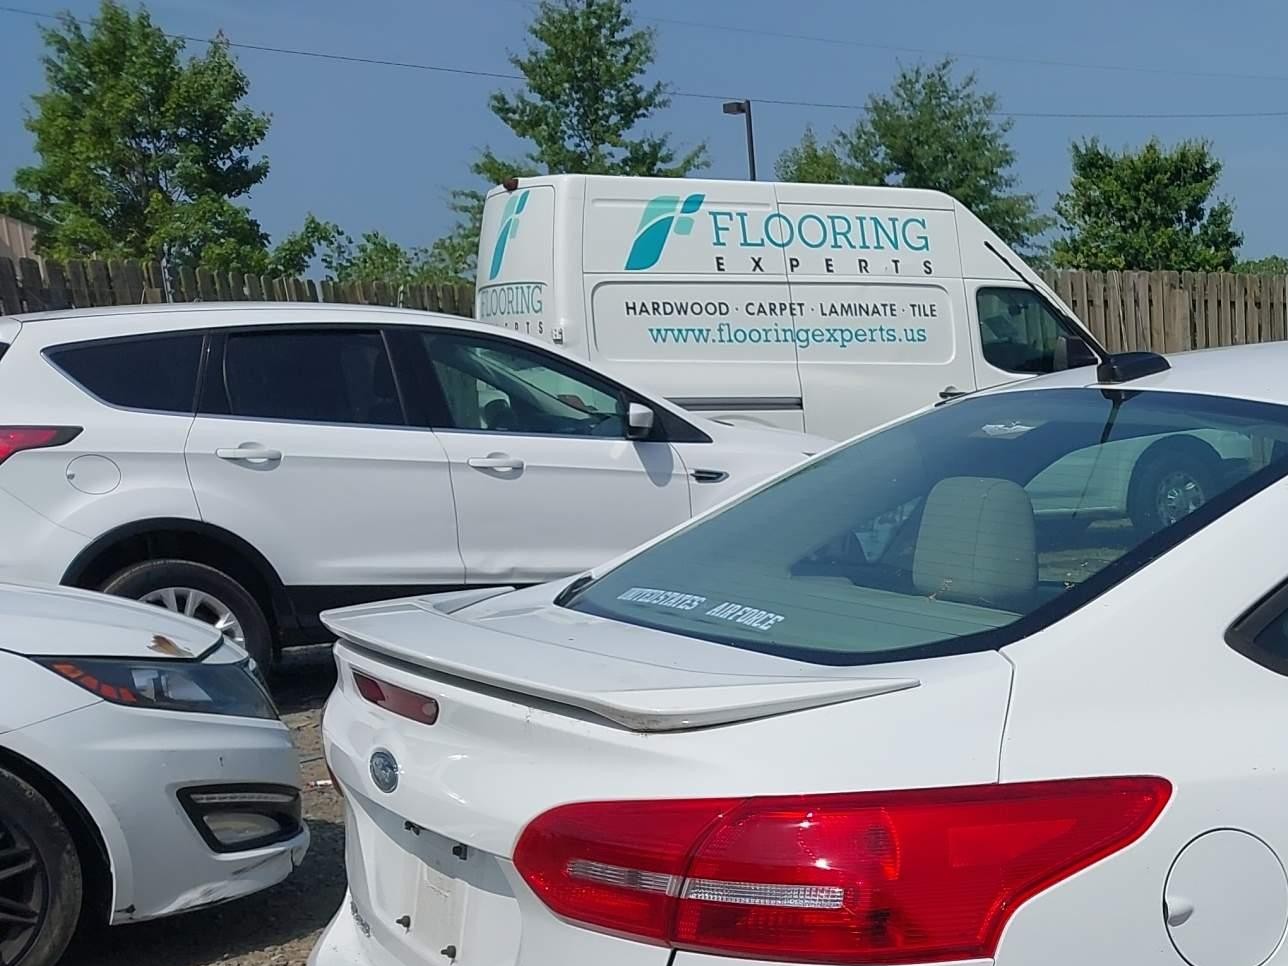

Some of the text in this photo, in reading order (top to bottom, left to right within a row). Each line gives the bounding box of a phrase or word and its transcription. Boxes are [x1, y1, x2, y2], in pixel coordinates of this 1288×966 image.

[708, 210, 930, 252] FLOORING
[715, 256, 933, 275] EXPERTS
[480, 285, 544, 318] FLOORING
[625, 301, 938, 318] HARDWOOD CARPET LAMINATE TILE
[648, 322, 928, 349] www.flooringexperts.us
[652, 591, 707, 610] STATES
[705, 602, 742, 619] AIR
[727, 607, 785, 631] FORCE
